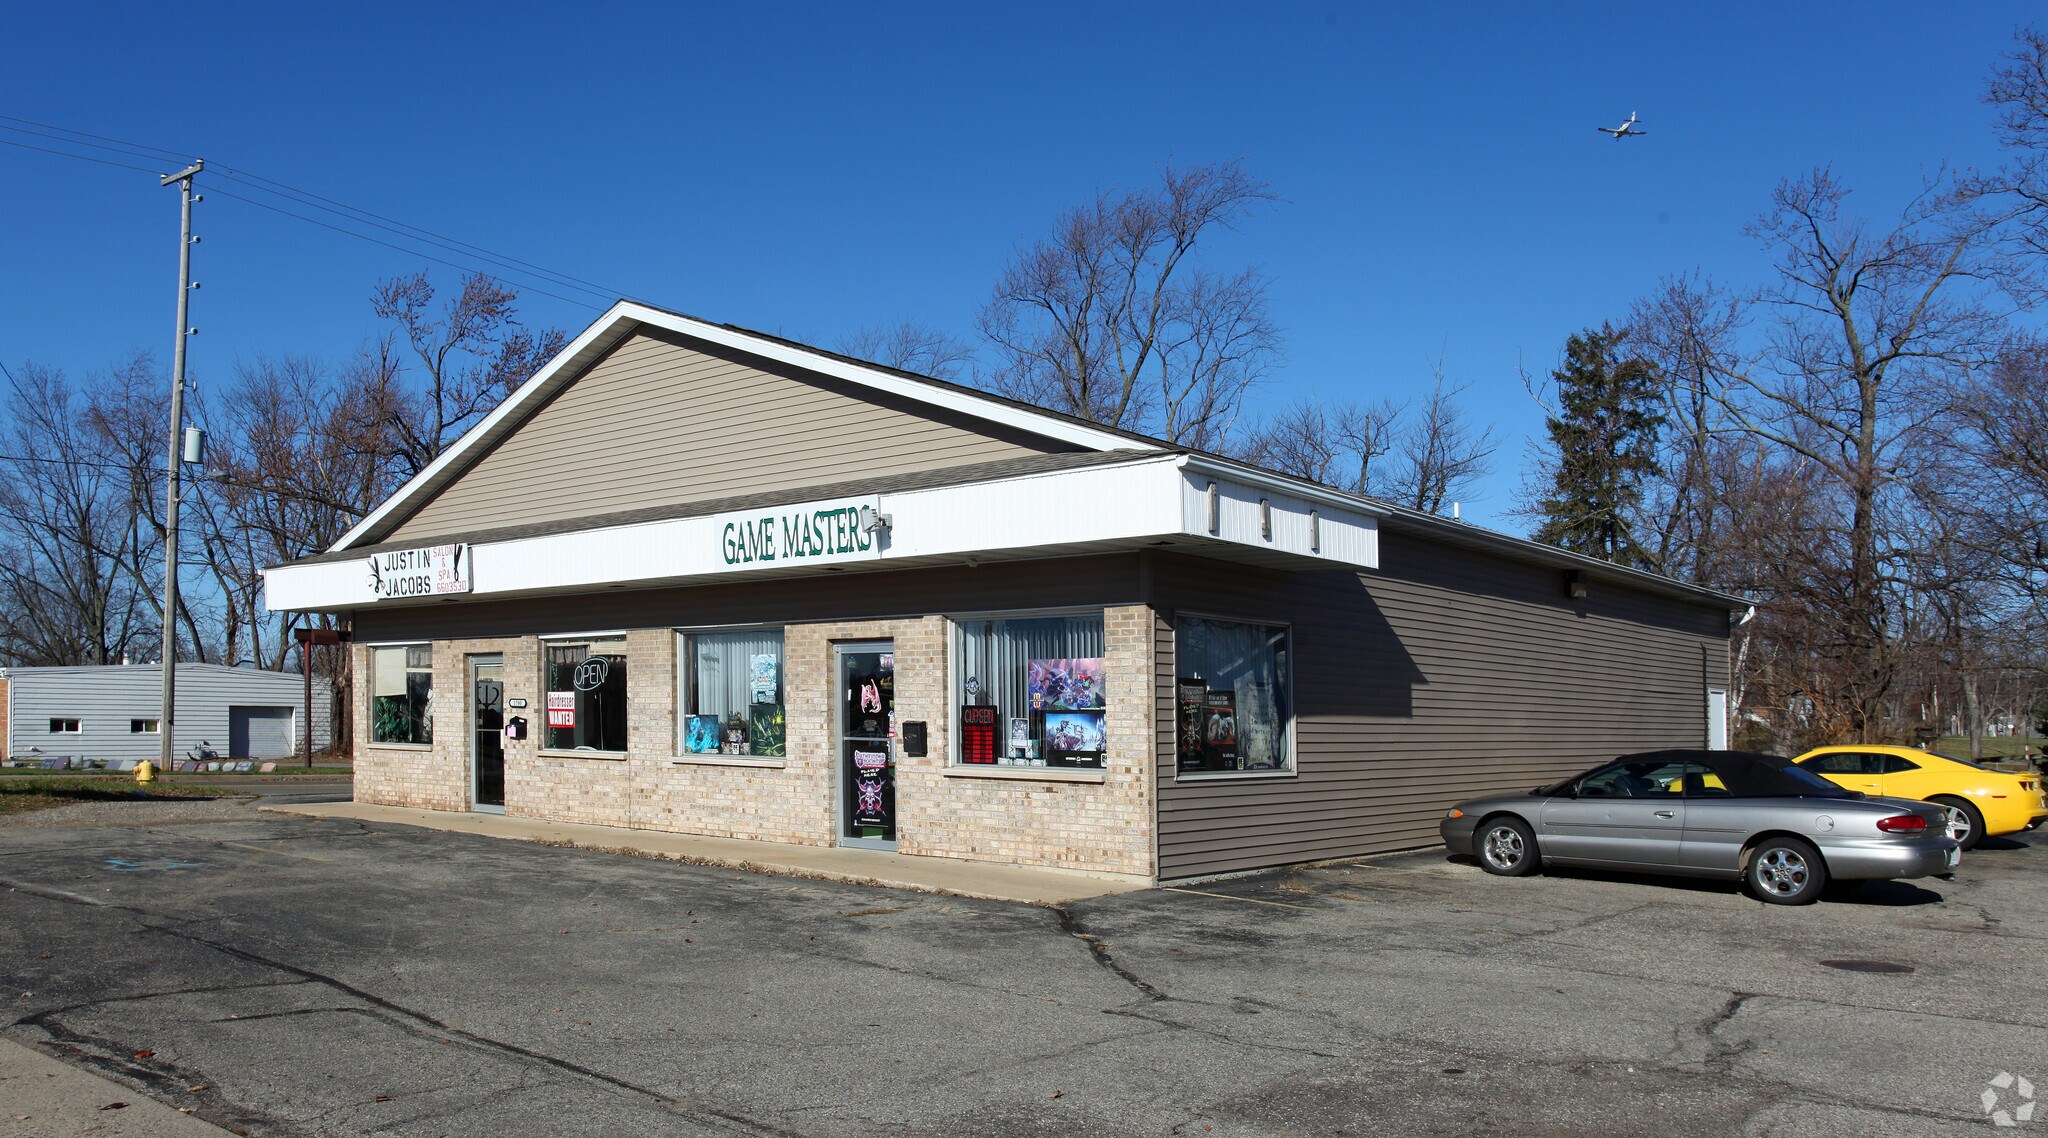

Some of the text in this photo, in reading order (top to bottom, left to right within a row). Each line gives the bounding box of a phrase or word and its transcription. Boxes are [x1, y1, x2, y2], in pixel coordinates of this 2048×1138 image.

[722, 504, 872, 564] GAME MASTERS
[432, 545, 454, 557] SALON
[384, 549, 431, 572] JUSTIN
[441, 557, 446, 568] &
[438, 569, 451, 581] SPA
[385, 575, 431, 597] JACOBS
[436, 580, 467, 593] 6603530
[574, 664, 606, 685] OPEN
[549, 711, 574, 725] WANTED
